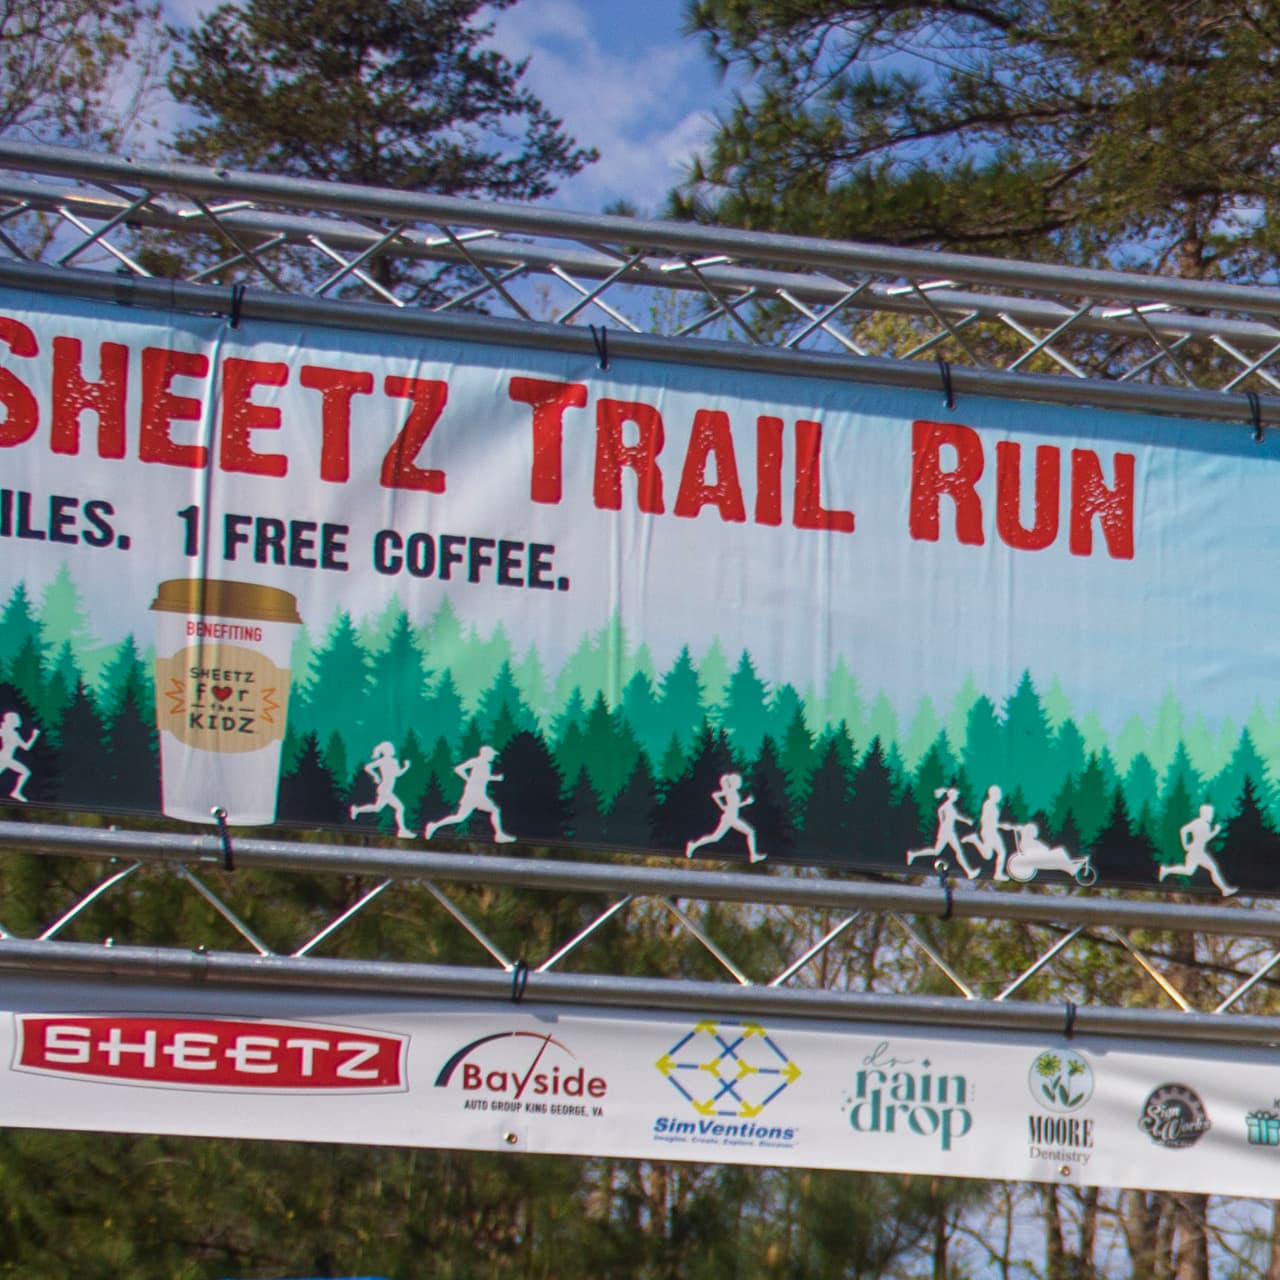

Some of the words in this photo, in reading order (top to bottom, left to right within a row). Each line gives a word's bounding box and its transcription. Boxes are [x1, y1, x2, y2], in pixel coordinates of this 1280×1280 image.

[508, 376, 855, 533] TRAIL
[909, 420, 1134, 560] RUN
[177, 506, 200, 557] 1
[223, 514, 349, 571] FREE
[374, 529, 570, 592] COFFEE.
[186, 621, 262, 641] BENEFITING
[190, 667, 255, 683] SHEETZ
[189, 713, 255, 733] KIDZ
[44, 1025, 380, 1080] SHEETZ
[462, 1062, 607, 1100] Bayside
[856, 1058, 966, 1105] rain
[464, 1100, 488, 1111] AUTO
[491, 1101, 522, 1113] GROUP
[525, 1102, 547, 1114] KING
[592, 1105, 603, 1117] VA
[850, 1089, 972, 1151] drop
[653, 1116, 794, 1140] SimVentions
[1028, 1114, 1094, 1148] MOORE
[1029, 1146, 1091, 1166] Dentistry
